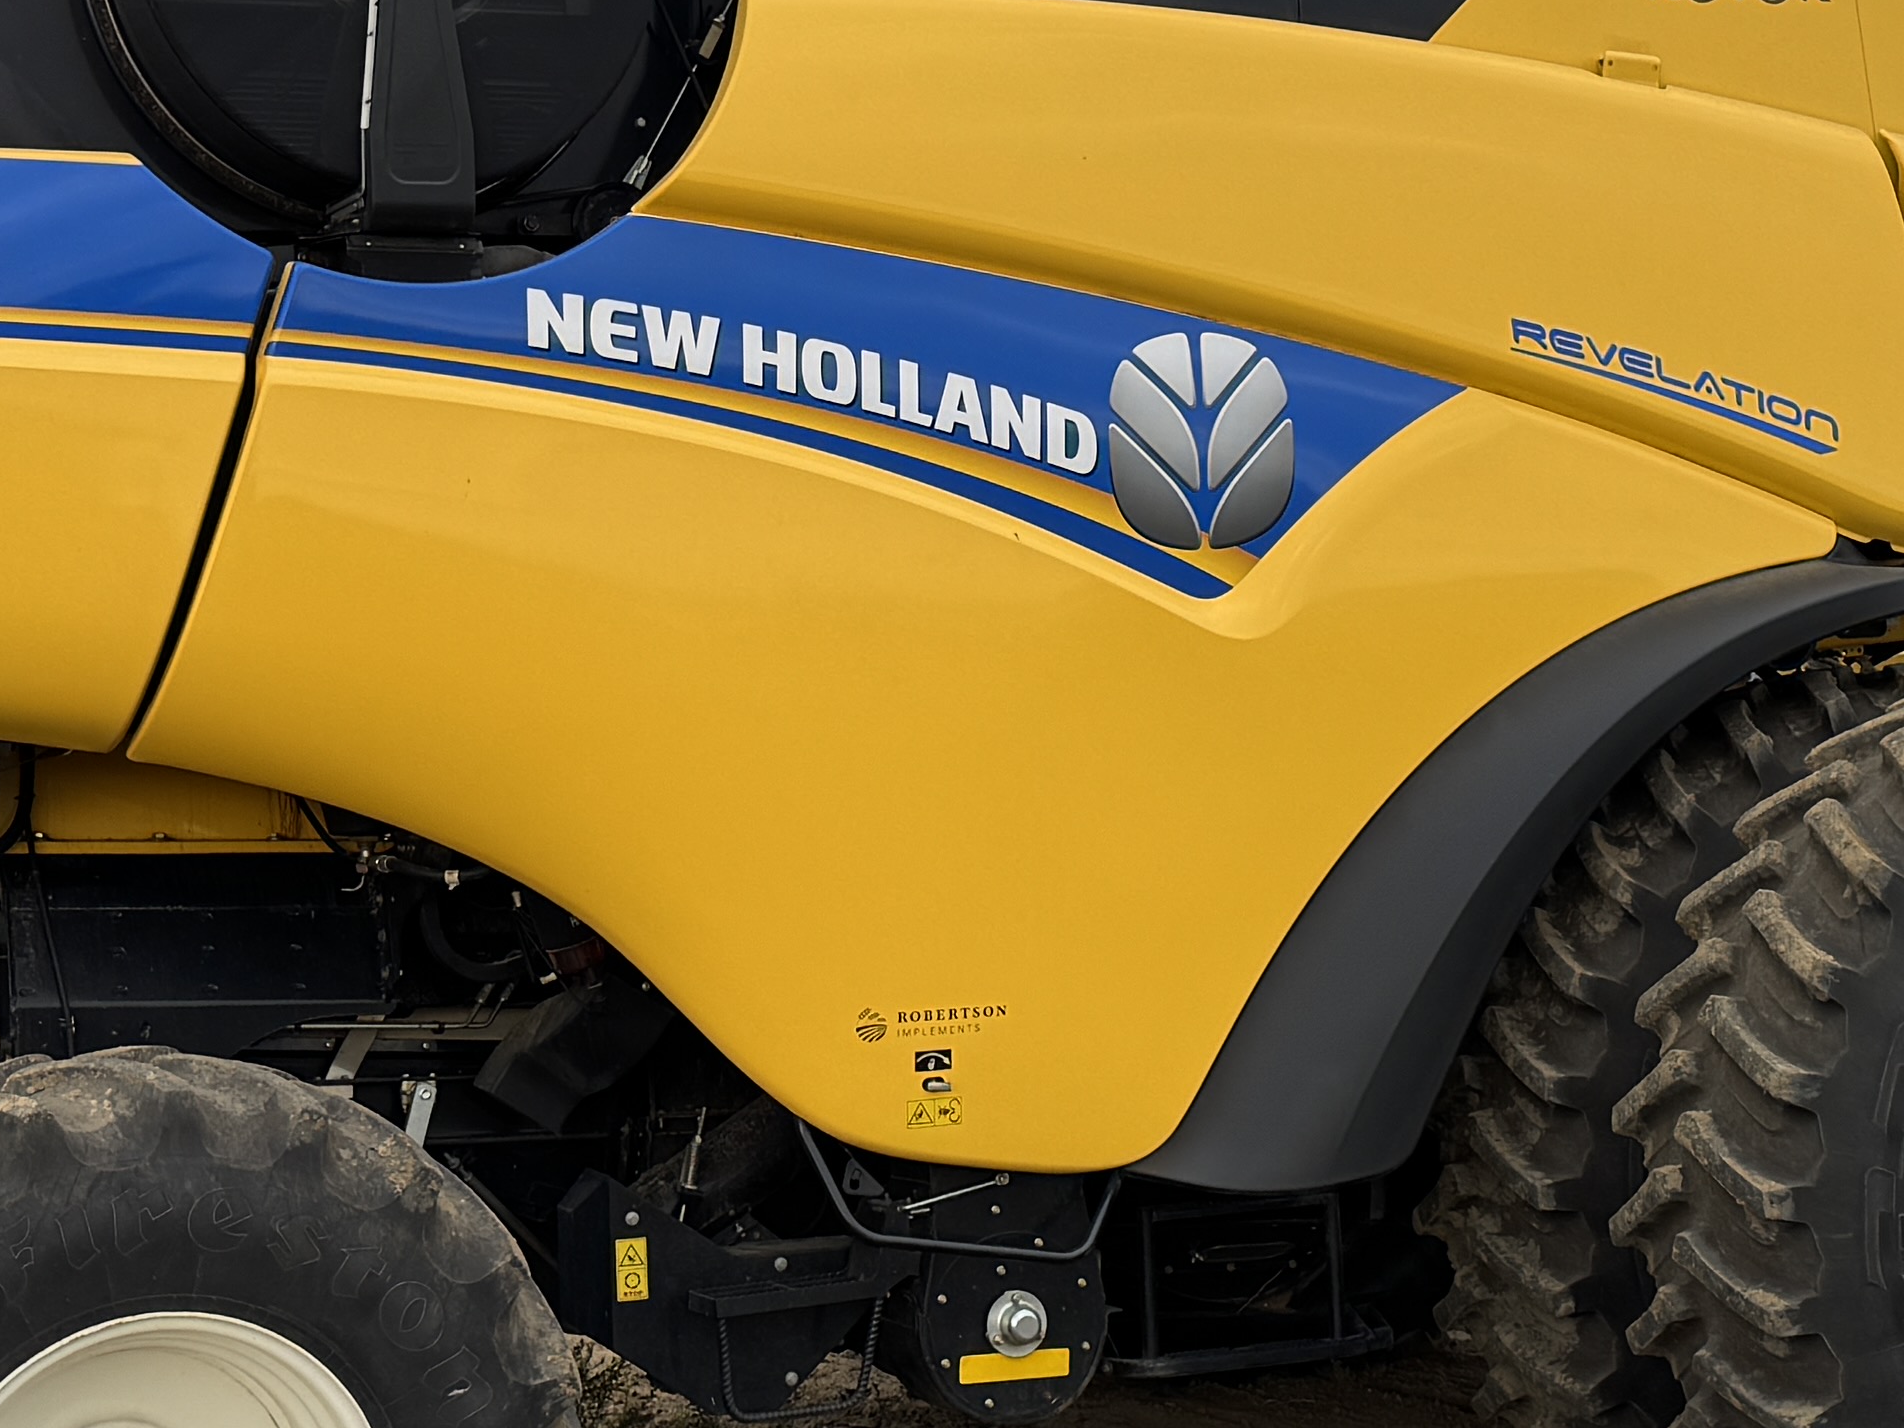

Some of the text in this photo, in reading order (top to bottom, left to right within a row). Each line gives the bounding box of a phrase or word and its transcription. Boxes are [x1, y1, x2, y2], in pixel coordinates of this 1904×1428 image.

[525, 287, 1100, 477] NEW HOLLAND
[1510, 317, 1840, 443] REVELATION
[897, 1005, 1007, 1023] ROBERTSON
[897, 1024, 981, 1037] IMPLEMENTS
